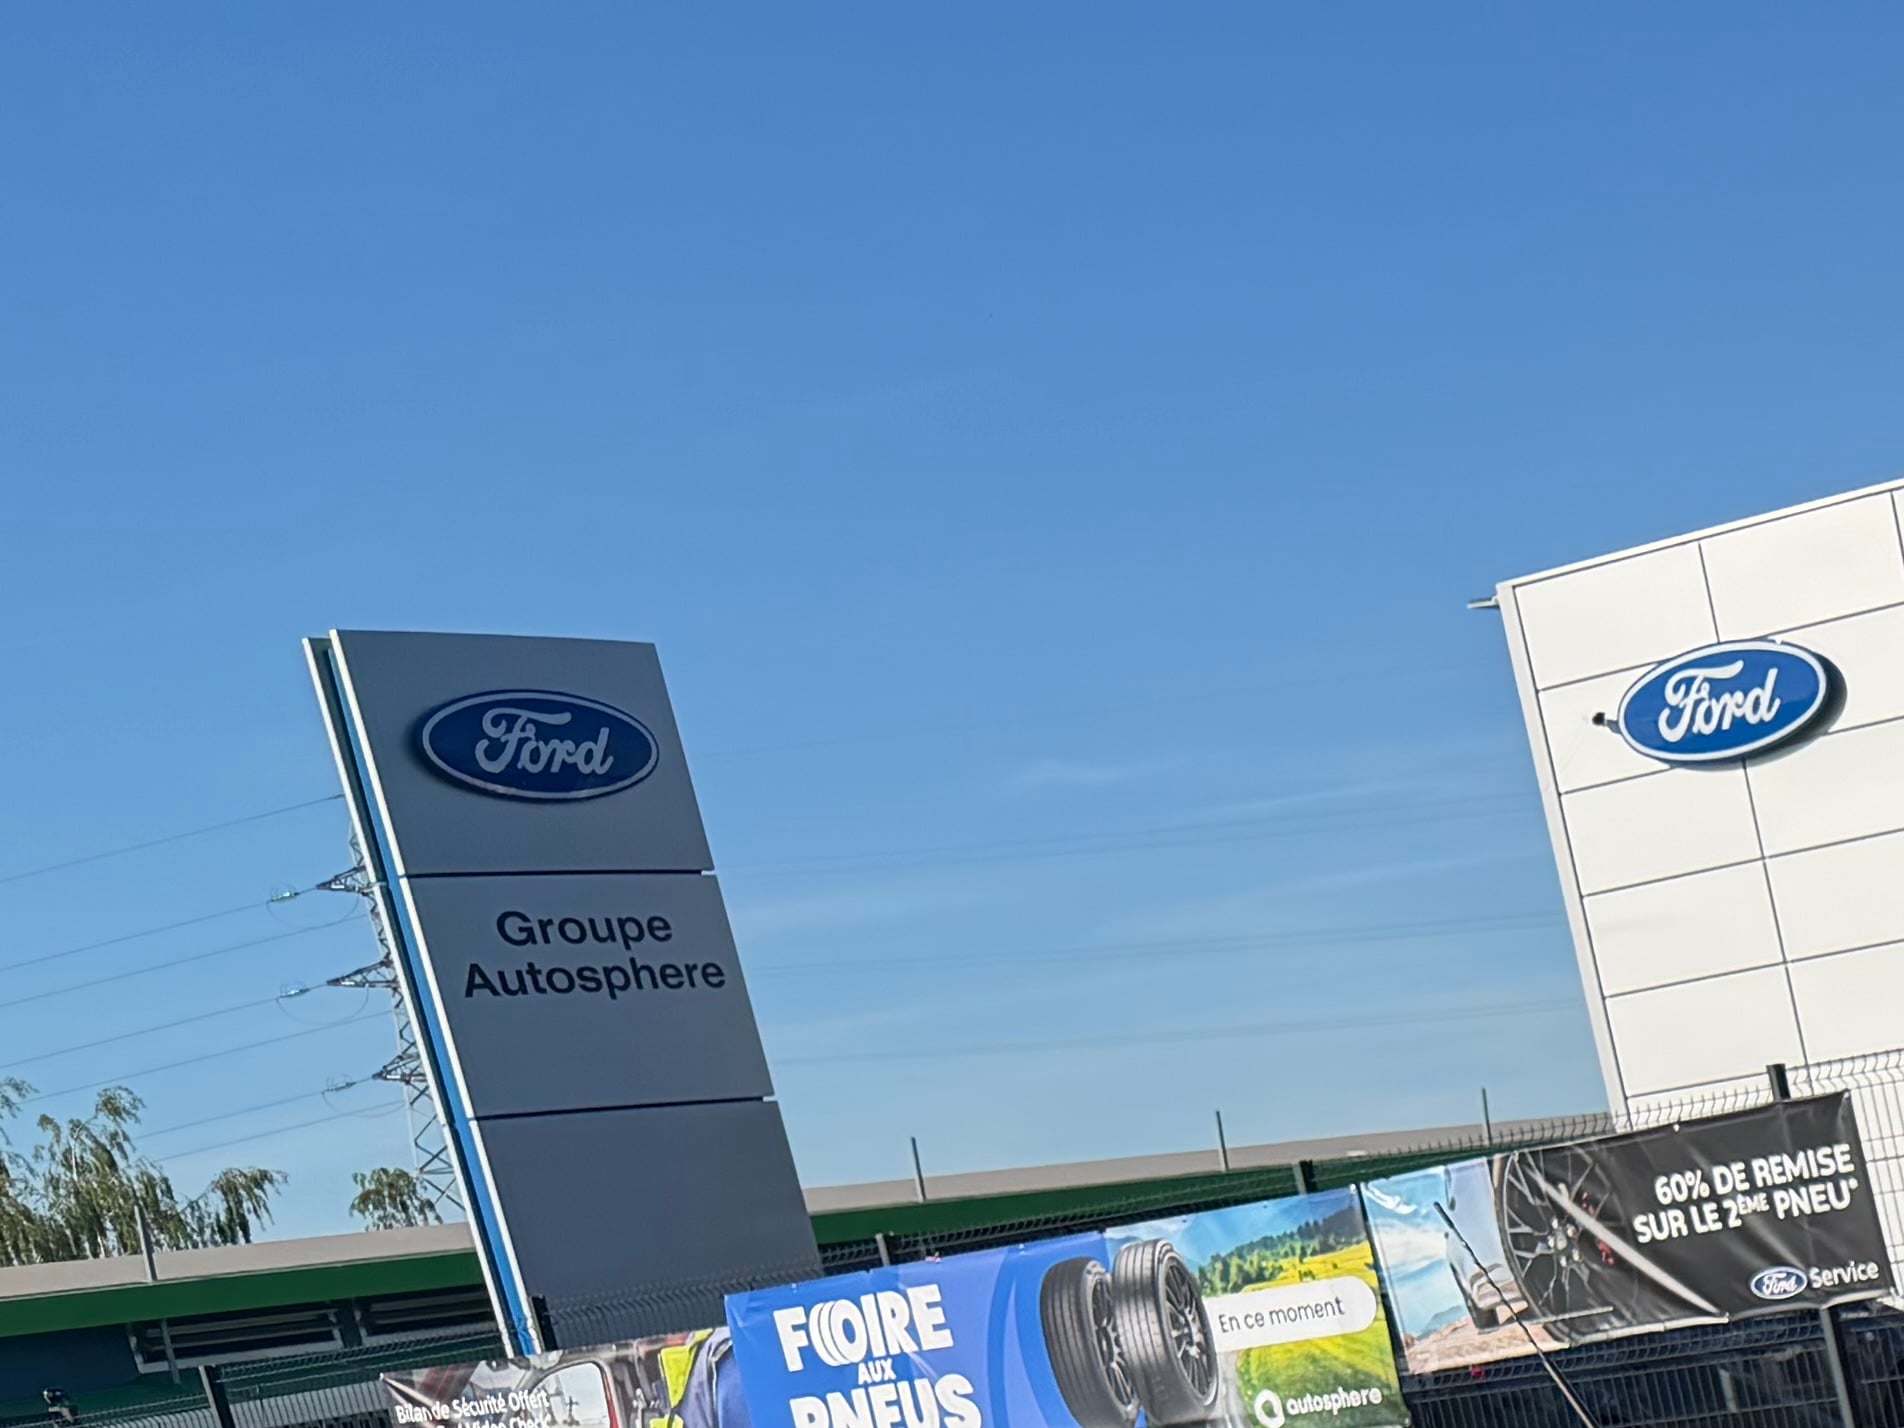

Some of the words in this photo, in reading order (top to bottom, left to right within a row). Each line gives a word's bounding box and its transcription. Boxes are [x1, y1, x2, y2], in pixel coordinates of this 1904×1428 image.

[1657, 658, 1781, 743] Ford
[474, 706, 614, 775] Ford
[495, 909, 673, 950] Groupe
[463, 956, 726, 1000] Autosphere
[1653, 1171, 1711, 1205] 60%
[1713, 1162, 1749, 1193] DE
[1751, 1143, 1855, 1187] REMISE
[1633, 1209, 1687, 1244] SUR
[1688, 1205, 1722, 1235] LE
[1759, 1271, 1797, 1295] Ford
[1808, 1259, 1880, 1290] Service
[1217, 1312, 1240, 1334] En
[1243, 1311, 1266, 1329] ce
[1270, 1294, 1347, 1326] moment
[856, 1358, 896, 1387] AUX
[395, 1402, 430, 1424] Bilan
[430, 1400, 449, 1416] de
[451, 1392, 506, 1420] Sécurité
[508, 1387, 549, 1412] Offert
[1285, 1384, 1383, 1416] autosphere
